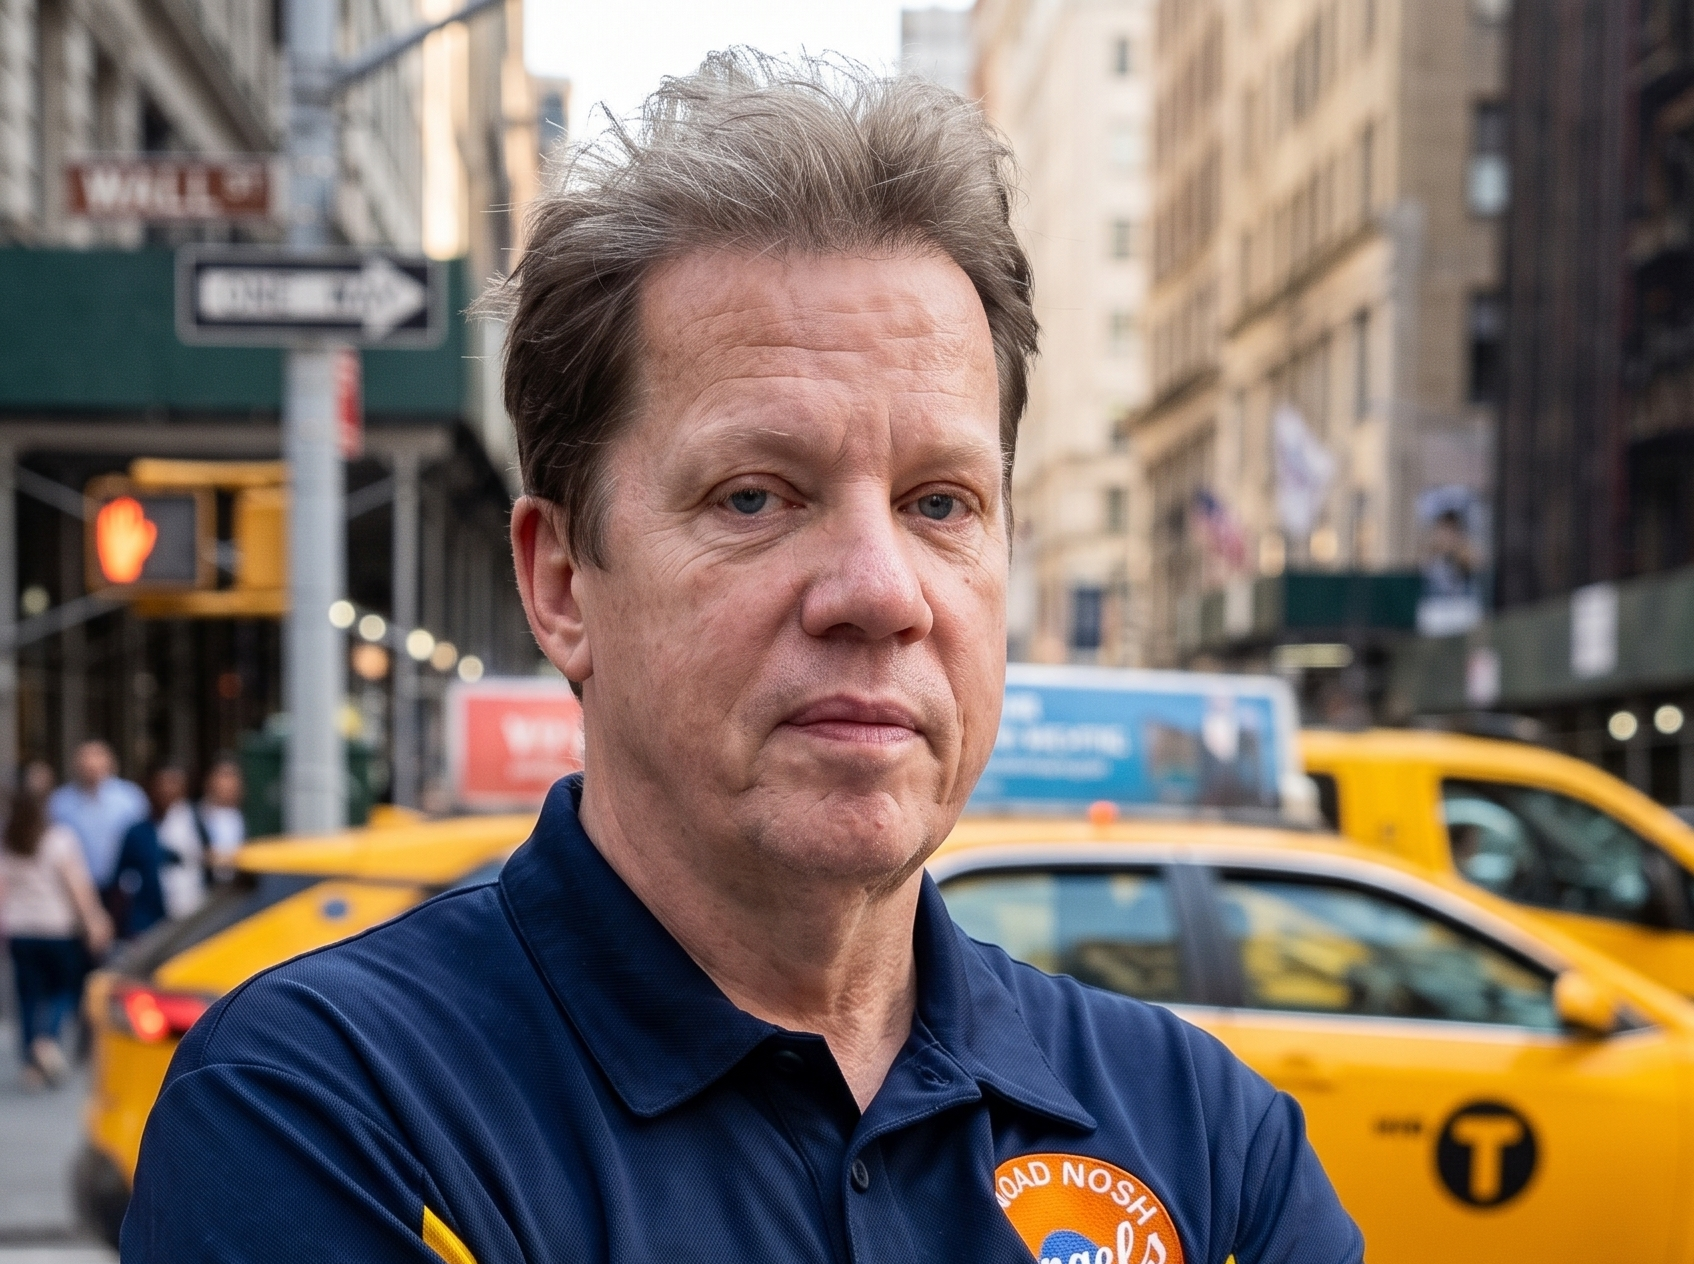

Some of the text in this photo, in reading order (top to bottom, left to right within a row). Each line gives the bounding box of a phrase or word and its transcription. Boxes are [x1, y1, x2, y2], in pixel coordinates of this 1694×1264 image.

[84, 168, 218, 217] WALL
[1451, 1113, 1522, 1201] T
[1062, 1161, 1157, 1226] NOSH
